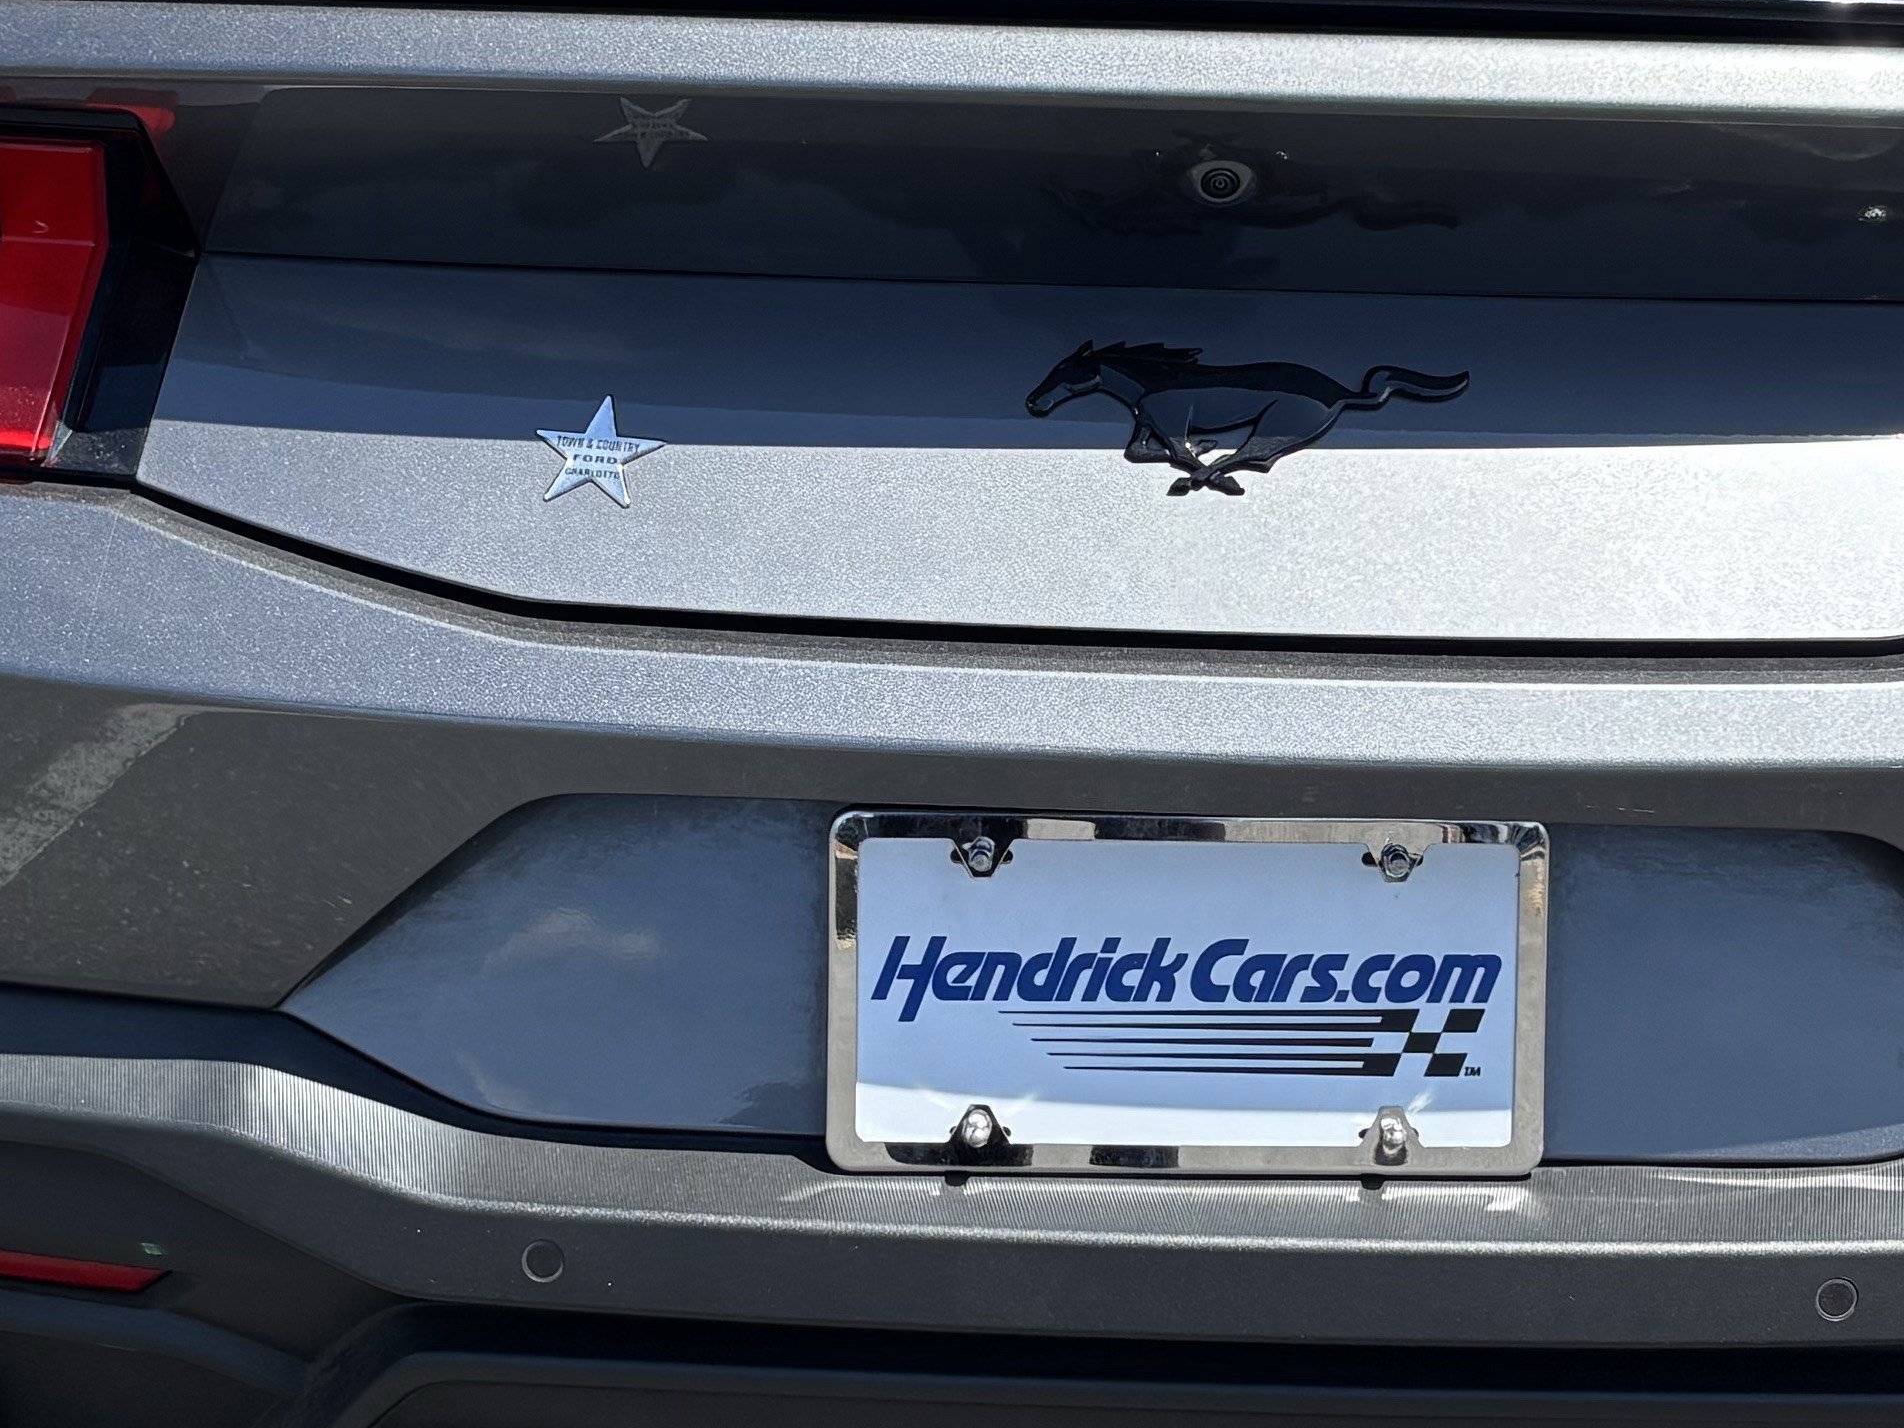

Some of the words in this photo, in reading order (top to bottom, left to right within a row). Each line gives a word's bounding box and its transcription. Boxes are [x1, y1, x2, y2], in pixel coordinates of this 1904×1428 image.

[557, 435, 585, 449] TOWN
[596, 439, 641, 453] COUNTRY
[573, 454, 618, 465] FORD
[565, 468, 621, 480] CHARLOTTE
